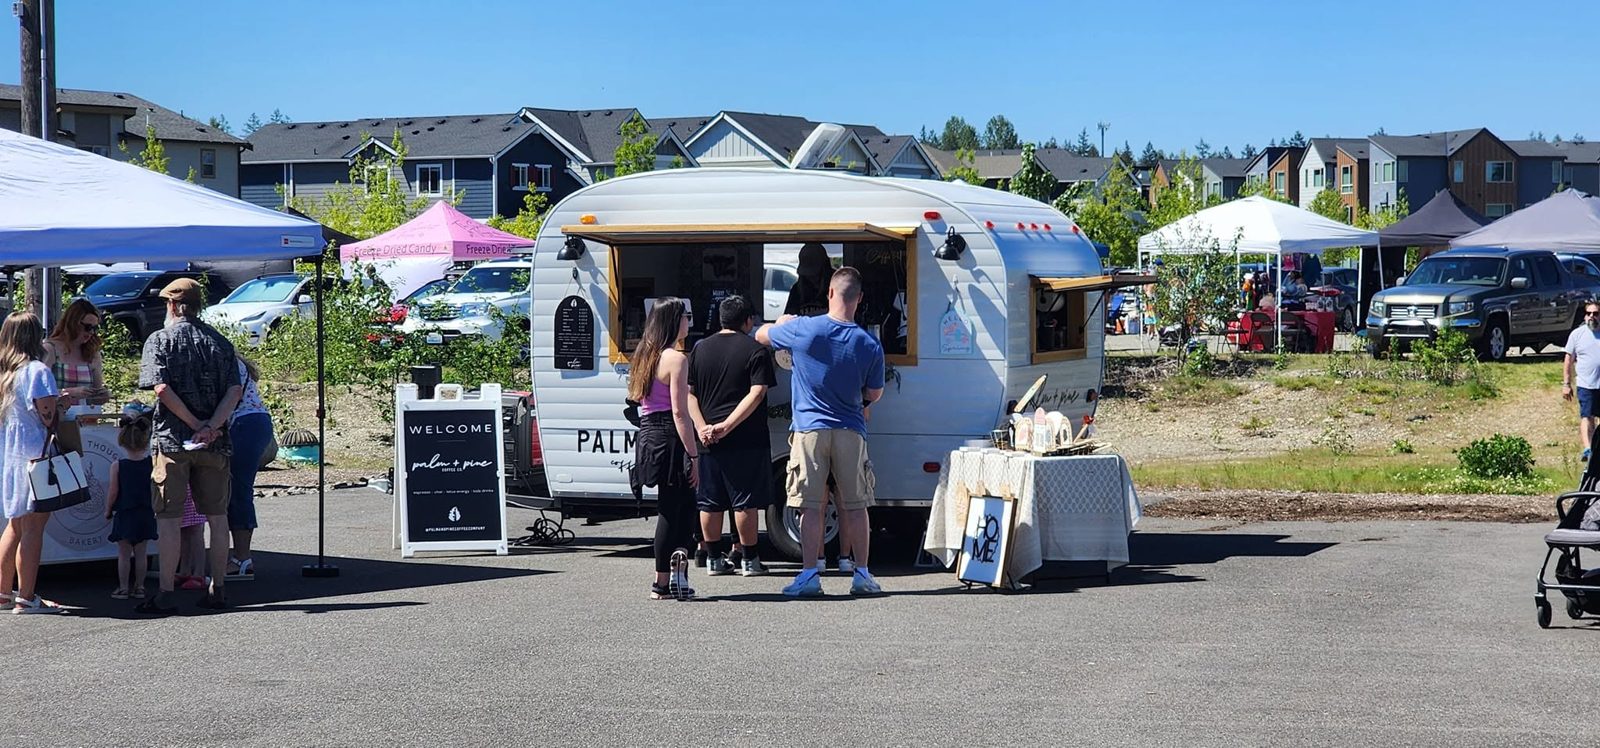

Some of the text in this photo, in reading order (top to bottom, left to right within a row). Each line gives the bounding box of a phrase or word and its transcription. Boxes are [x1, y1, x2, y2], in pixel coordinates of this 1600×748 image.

[383, 244, 408, 255] Dried
[409, 242, 437, 254] Candy
[466, 244, 490, 255] Freeze
[409, 423, 493, 435] WELCOME
[577, 429, 638, 454] PALM
[411, 453, 450, 472] palm
[462, 459, 493, 471] pine
